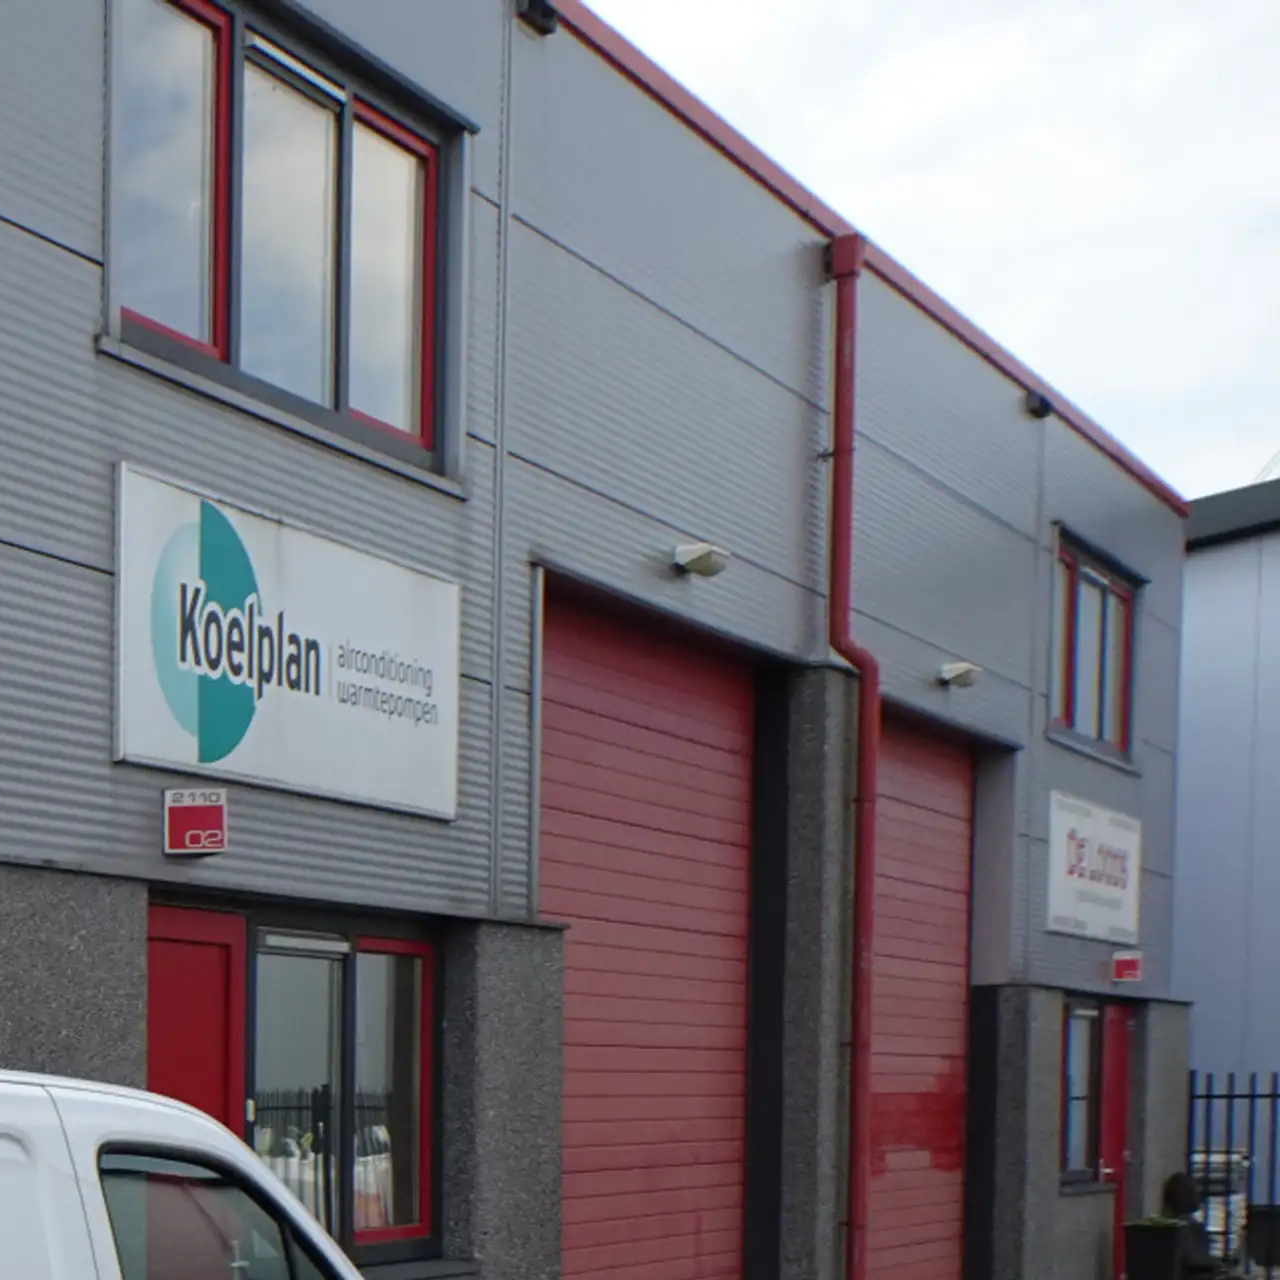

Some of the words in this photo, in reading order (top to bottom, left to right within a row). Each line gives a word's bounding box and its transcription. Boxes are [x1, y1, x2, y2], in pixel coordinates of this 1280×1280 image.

[179, 583, 321, 700] Koelplan
[337, 639, 434, 698] airconditioning
[337, 681, 438, 728] warmtepompen
[171, 791, 222, 804] 2110
[184, 829, 224, 848] 02
